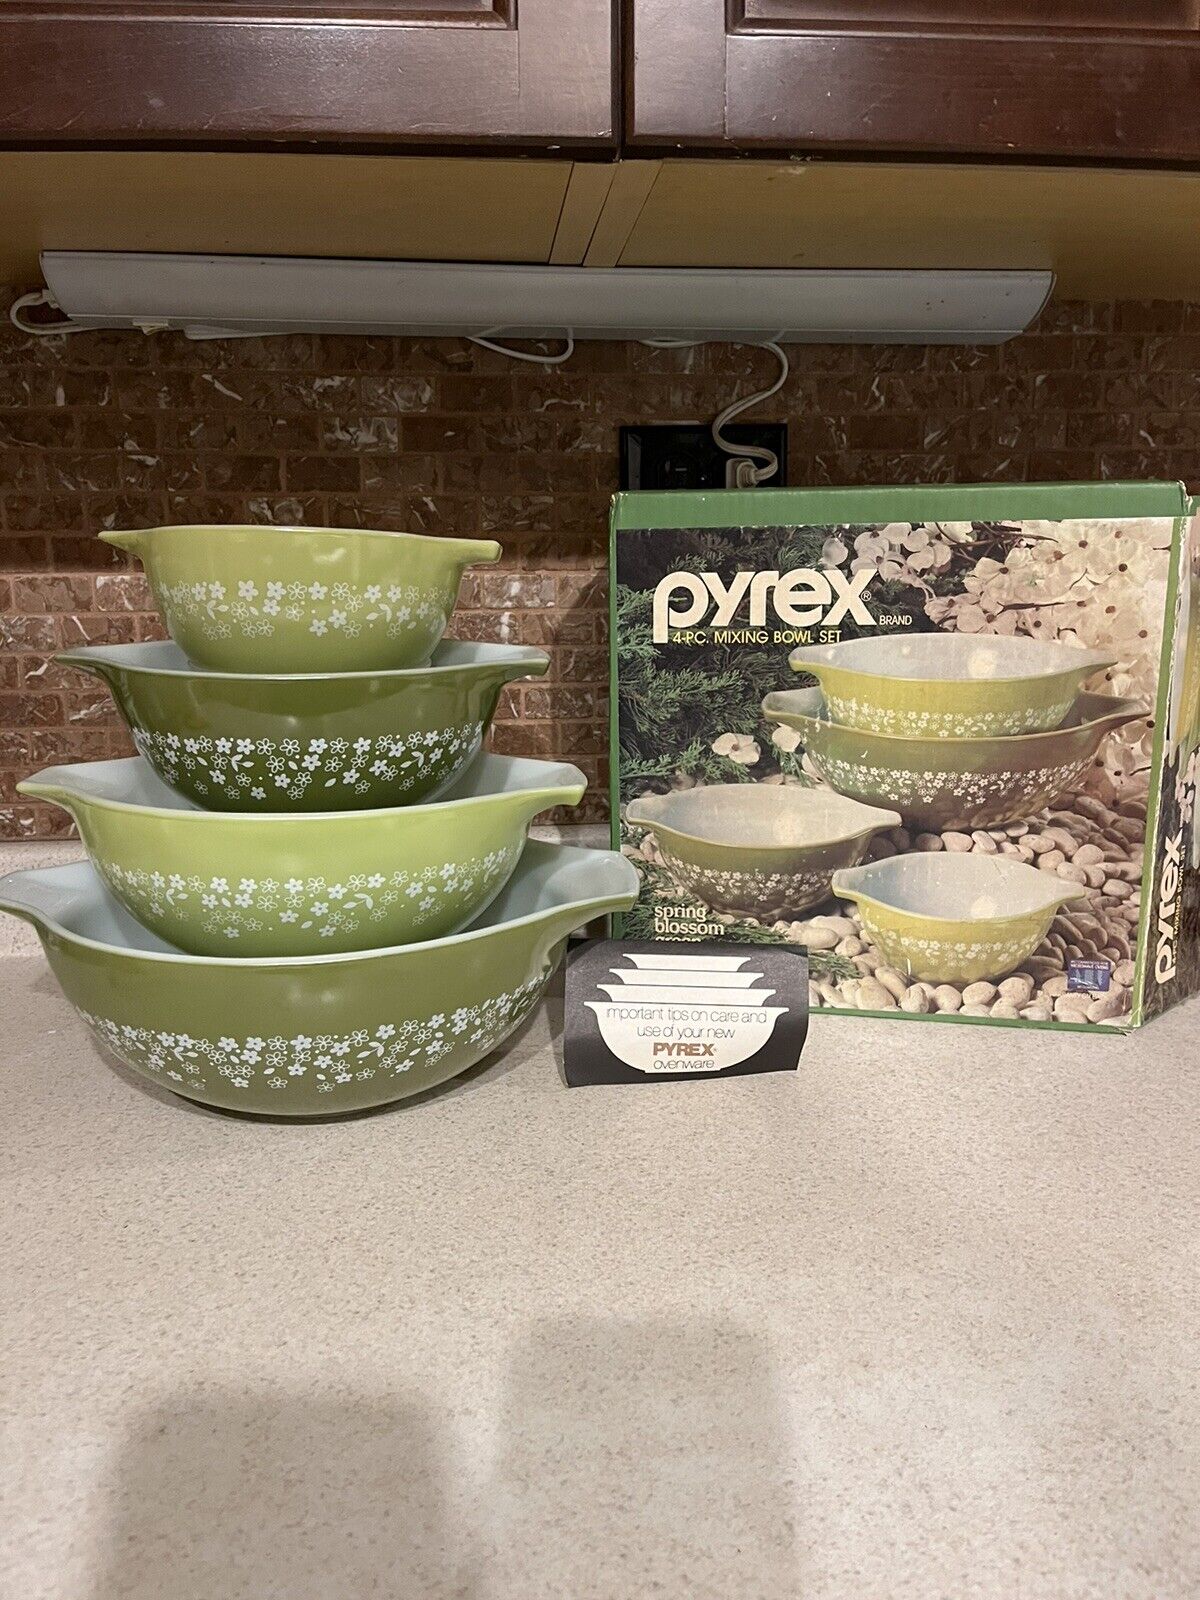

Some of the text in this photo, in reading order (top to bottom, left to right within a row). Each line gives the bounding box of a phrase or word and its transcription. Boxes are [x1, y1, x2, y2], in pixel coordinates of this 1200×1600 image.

[879, 615, 913, 626] BRAND
[714, 630, 769, 644] MIXING
[773, 630, 815, 644] BOWL
[819, 630, 843, 643] SET
[654, 903, 707, 922] spring
[1155, 828, 1184, 984] pyrex
[654, 917, 725, 936] blossom
[667, 1007, 690, 1023] tips
[690, 1010, 709, 1022] on
[710, 1010, 739, 1023] care
[741, 1009, 768, 1024] and
[637, 1023, 736, 1042] use of your new
[653, 1059, 715, 1071] ovenware
